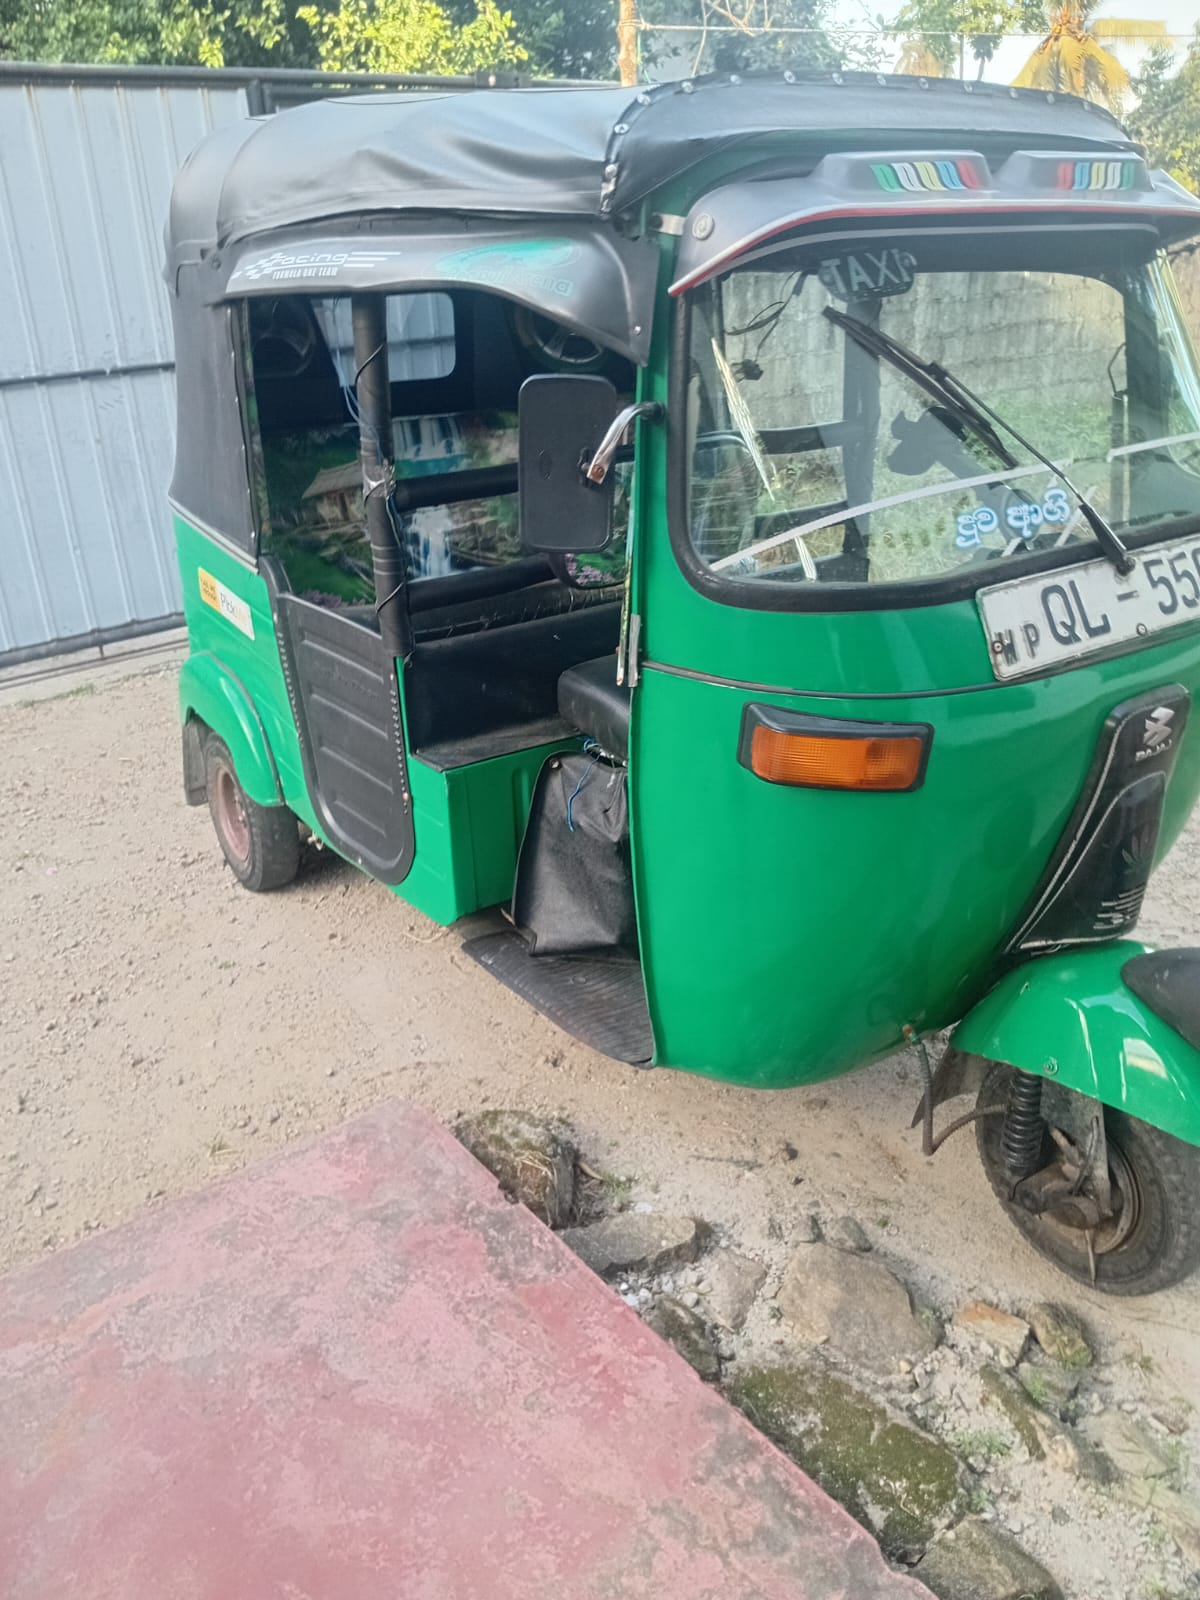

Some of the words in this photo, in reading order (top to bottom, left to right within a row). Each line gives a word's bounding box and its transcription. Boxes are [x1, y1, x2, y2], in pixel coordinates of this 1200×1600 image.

[302, 268, 316, 277] ONE
[318, 266, 338, 277] TEAM
[820, 248, 912, 294] TAXI
